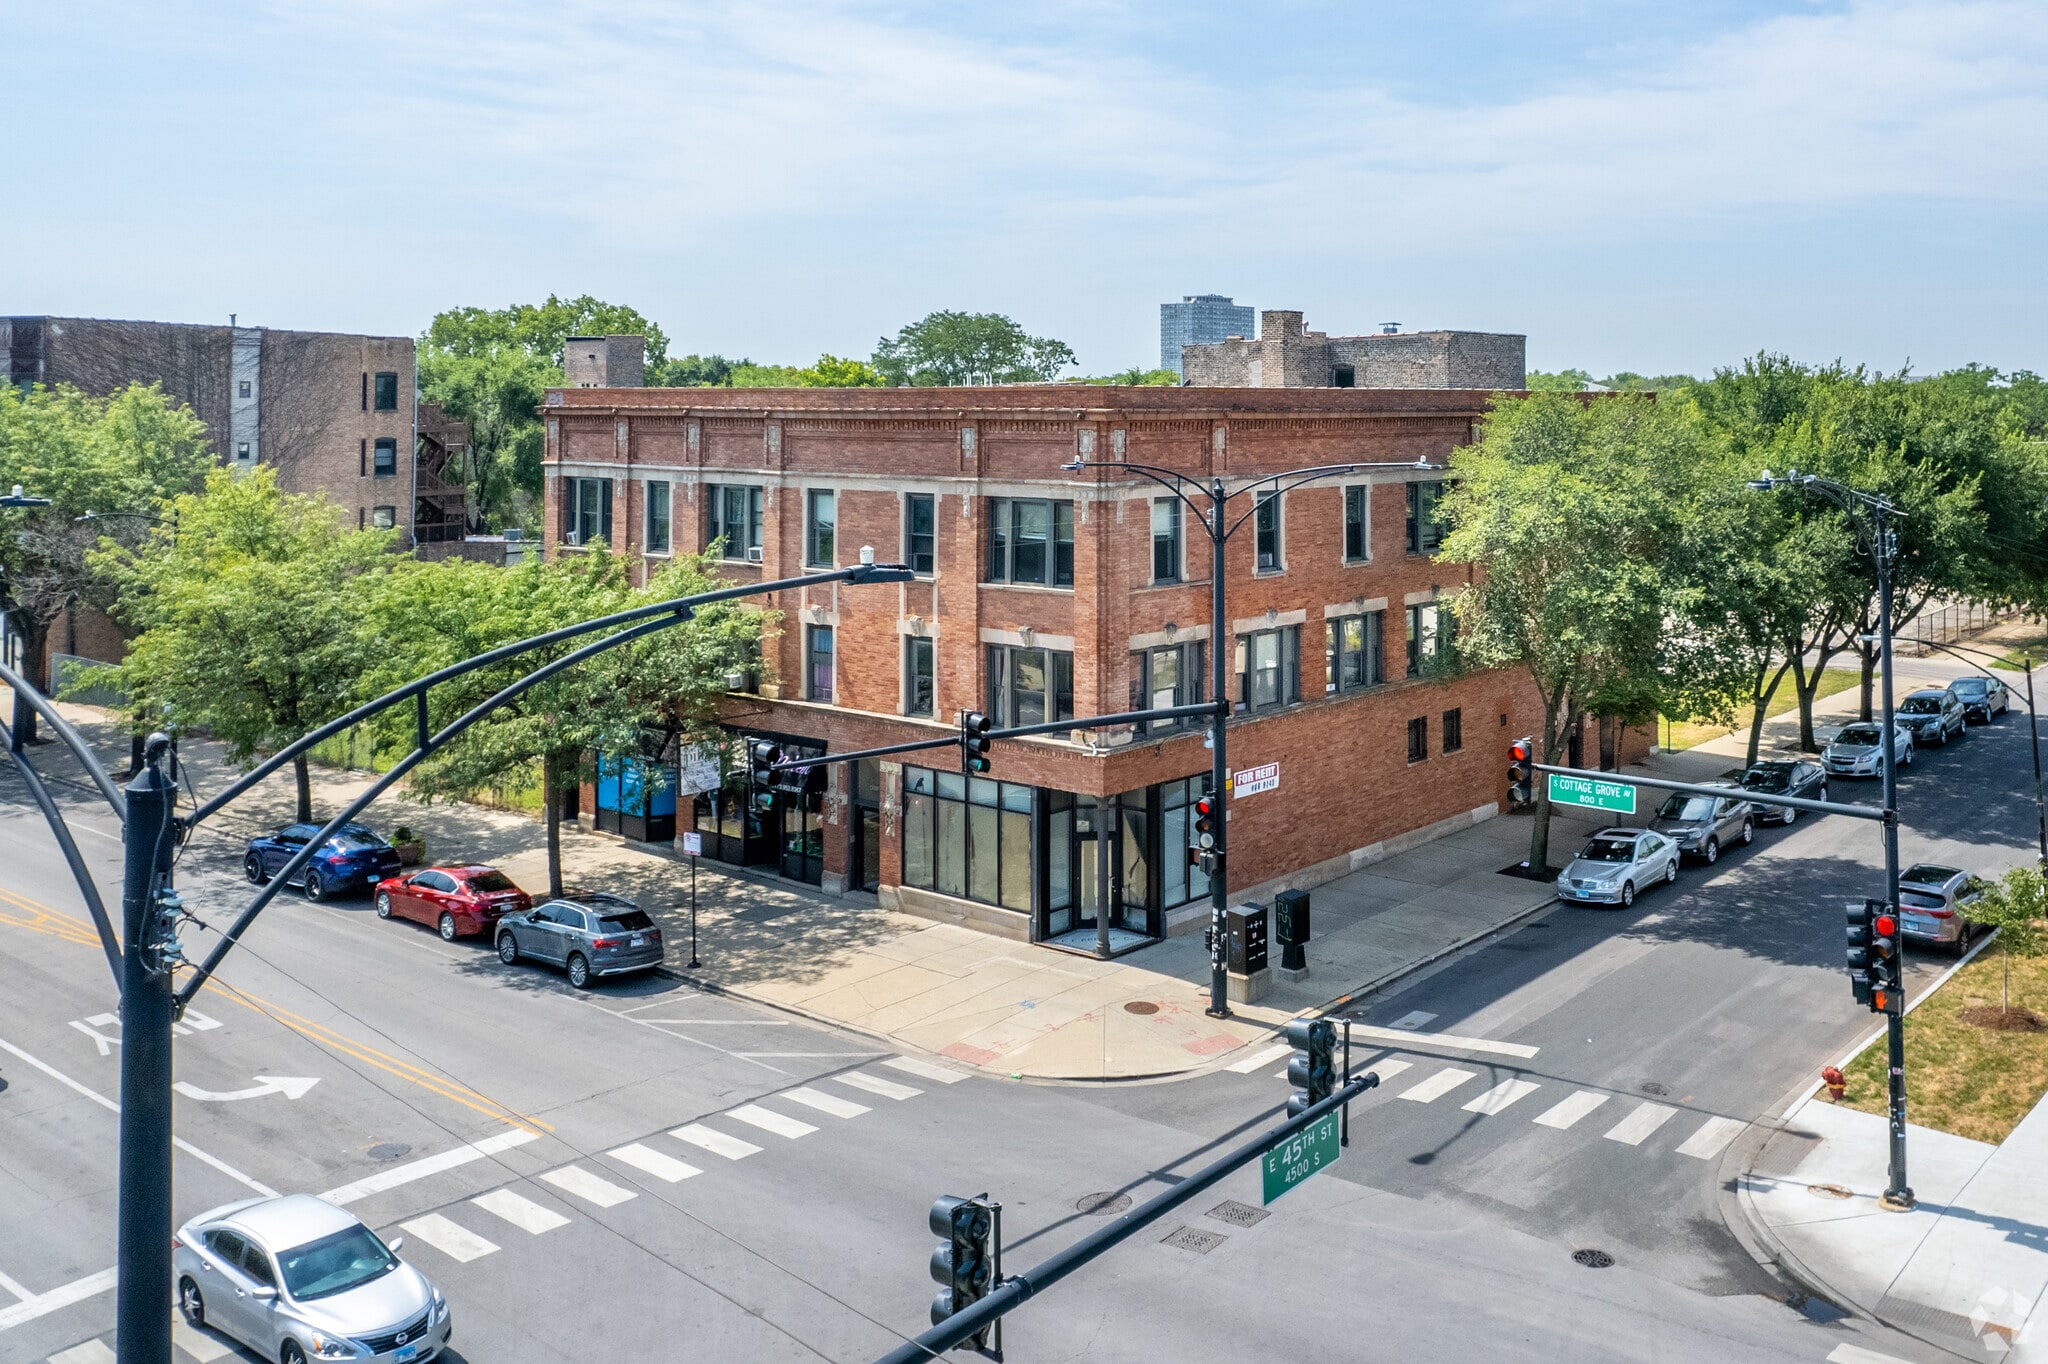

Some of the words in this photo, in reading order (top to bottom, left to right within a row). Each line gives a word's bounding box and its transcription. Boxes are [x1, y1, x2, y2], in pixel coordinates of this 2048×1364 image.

[1237, 771, 1254, 785] FOR
[1255, 766, 1275, 780] RENT
[1553, 779, 1558, 787] S
[1559, 779, 1592, 794] COTTAGE
[1595, 786, 1621, 798] GROVE
[1623, 790, 1631, 798] AV
[1579, 795, 1595, 804] 800
[1598, 798, 1604, 806] E
[1269, 1158, 1276, 1173] E
[1282, 1131, 1315, 1165] 45TH
[1320, 1122, 1333, 1140] ST
[1284, 1159, 1309, 1183] 4500
[1314, 1152, 1320, 1166] S
